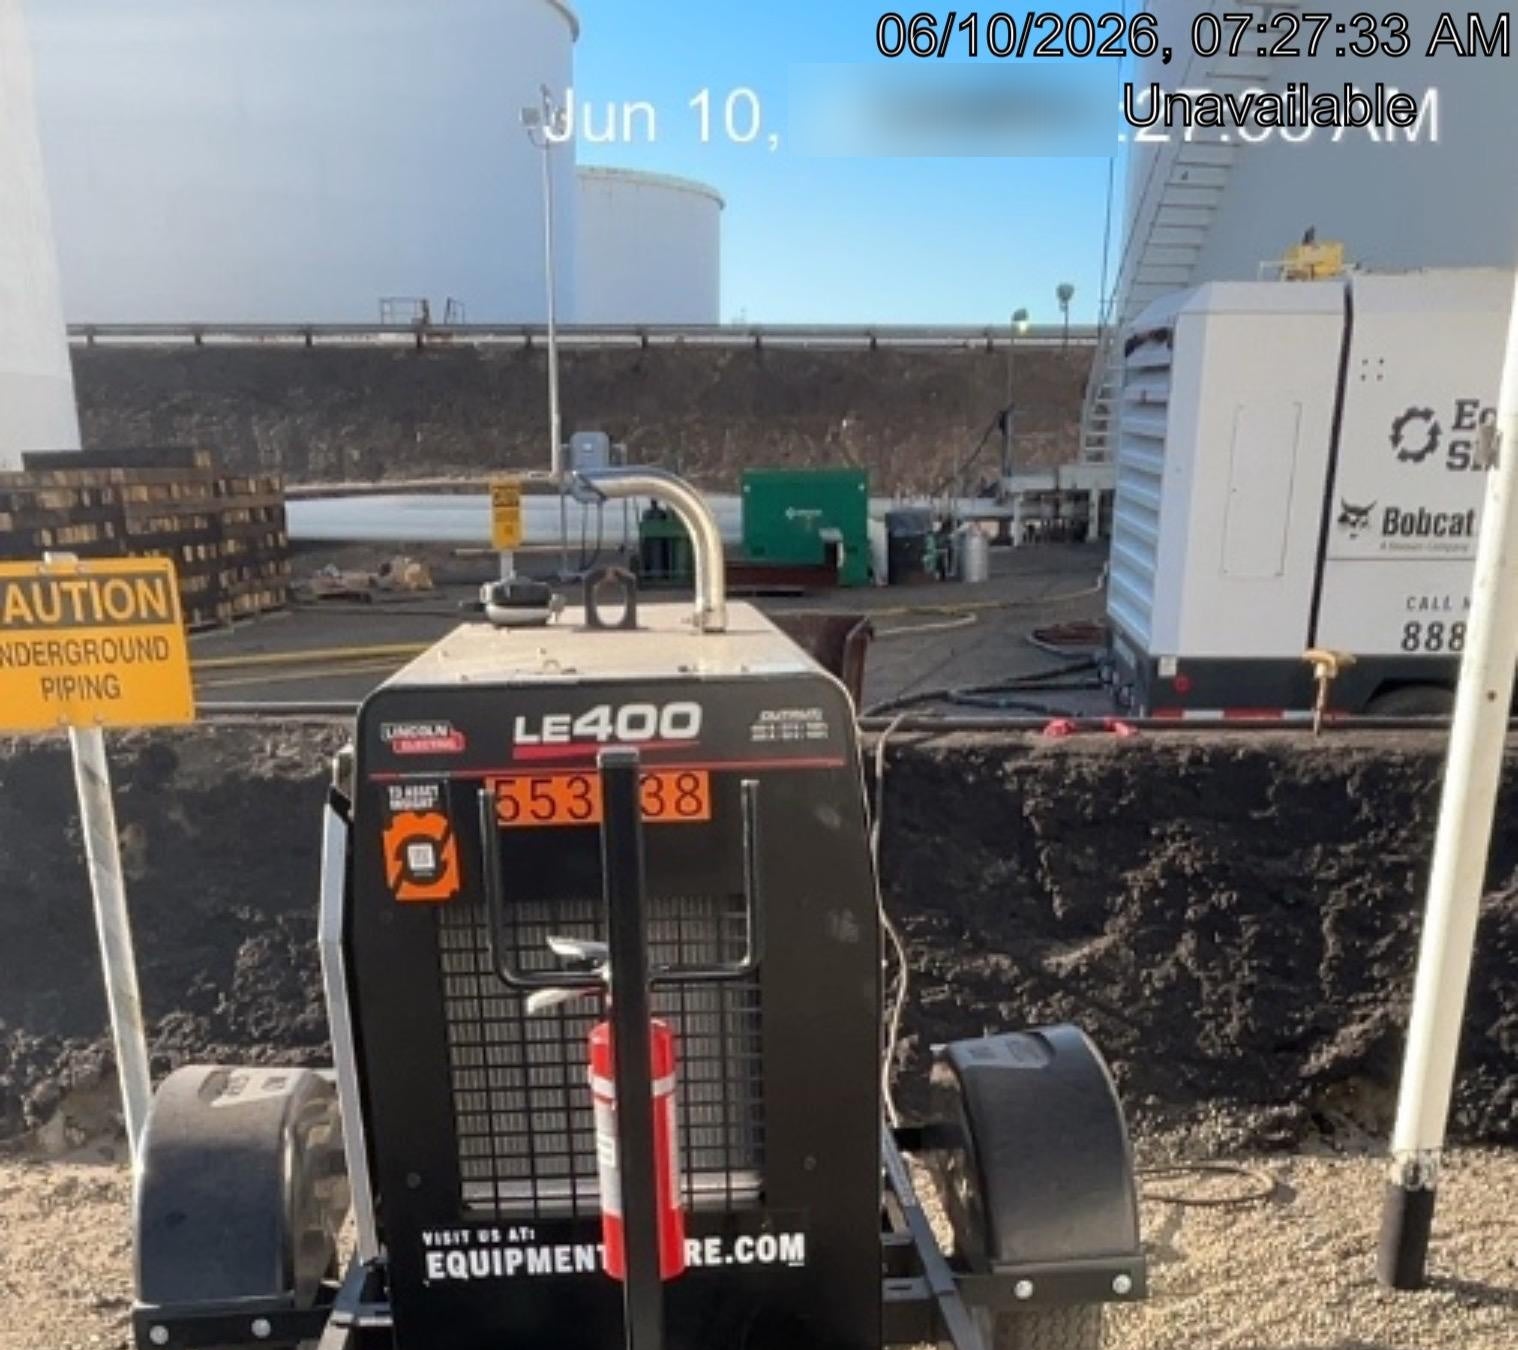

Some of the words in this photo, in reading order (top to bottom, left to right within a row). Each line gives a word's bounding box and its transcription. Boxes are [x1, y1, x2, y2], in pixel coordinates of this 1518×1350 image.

[1382, 506, 1475, 537] Bobcat
[0, 577, 169, 624] AUTION
[1406, 595, 1452, 612] CALL
[0, 634, 170, 668] NDERGROUND
[41, 672, 121, 702] PIPING
[513, 701, 703, 744] LE400
[494, 772, 702, 822] 55338
[422, 1229, 470, 1246] VISIT
[477, 1228, 502, 1243] US
[509, 1226, 536, 1241] AT:
